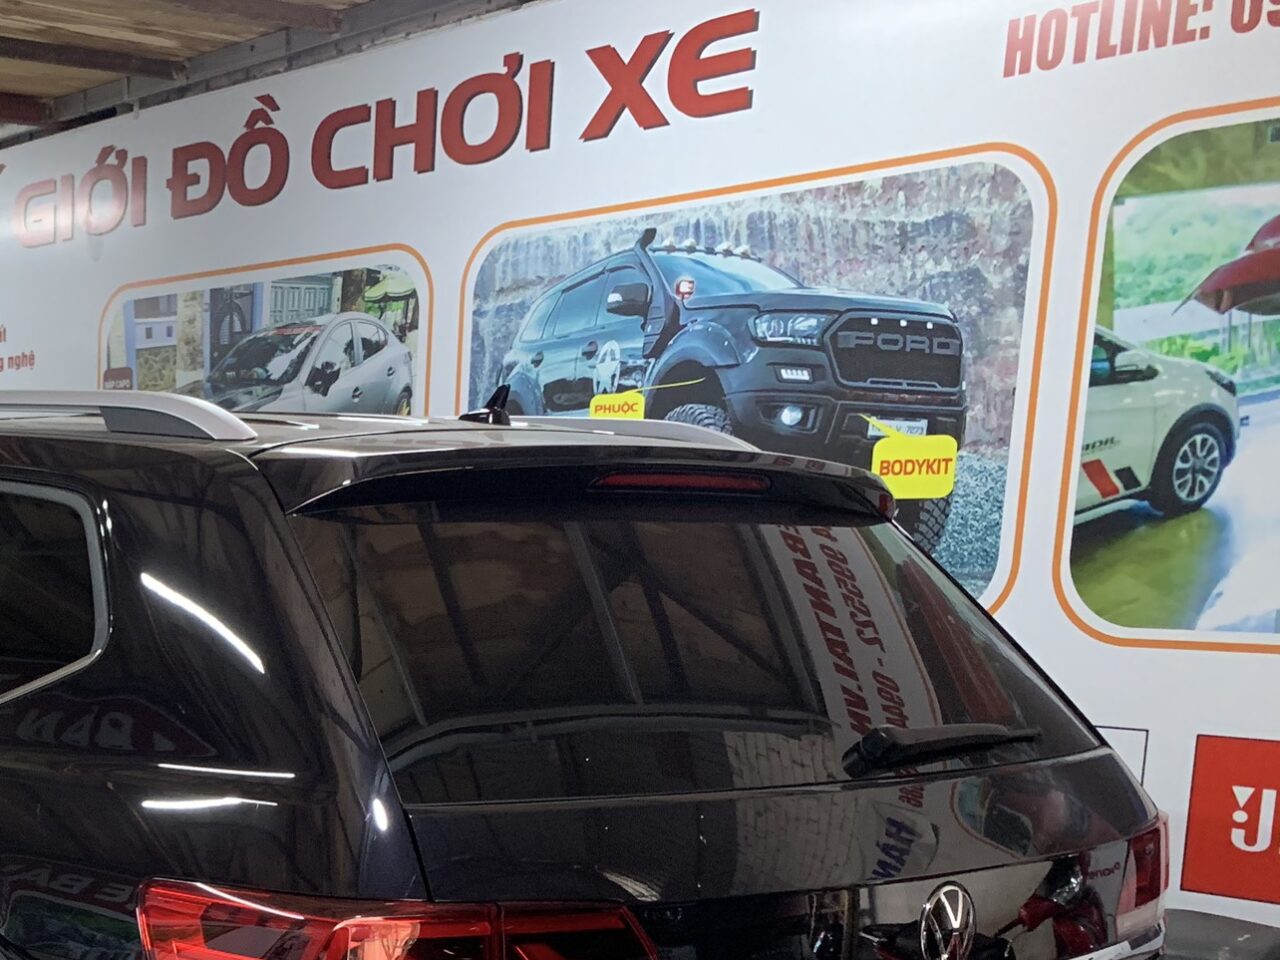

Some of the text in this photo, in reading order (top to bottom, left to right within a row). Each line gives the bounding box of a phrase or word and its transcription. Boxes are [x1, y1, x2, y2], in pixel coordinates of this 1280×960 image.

[1003, 0, 1213, 78] HOTLINE:
[14, 144, 148, 248] GIỚI
[166, 94, 290, 220] ĐỒ
[312, 51, 555, 190] CHƠI
[580, 8, 760, 142] XE
[837, 330, 961, 357] FORD
[7, 350, 35, 371] nghệ
[595, 401, 639, 415] PHUỘC
[879, 458, 953, 476] BODYKIT
